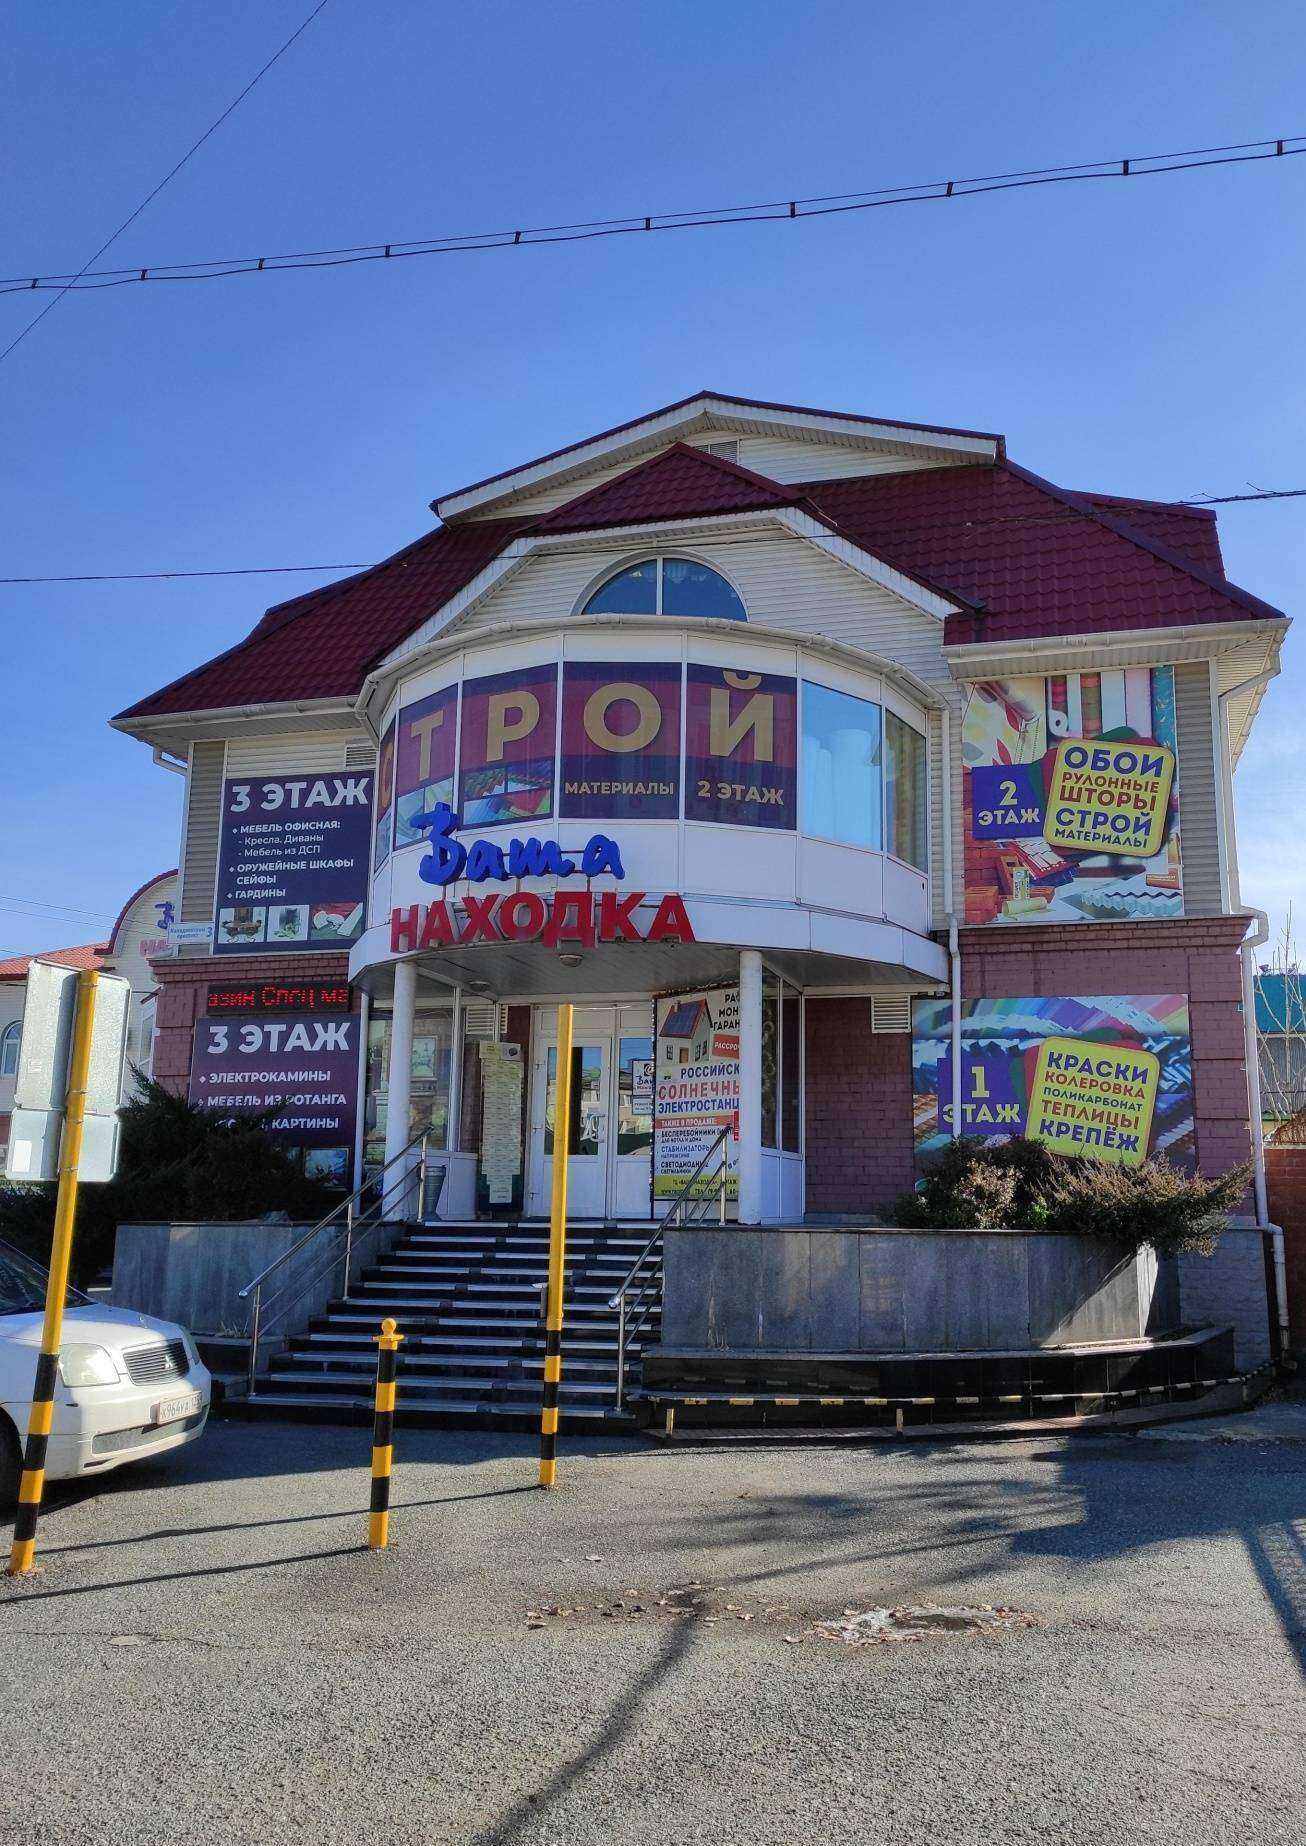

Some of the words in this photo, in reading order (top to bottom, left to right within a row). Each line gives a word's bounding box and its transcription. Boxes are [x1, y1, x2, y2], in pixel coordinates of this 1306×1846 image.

[1064, 746, 1164, 777] ОБОИ
[230, 785, 251, 812] 3
[260, 778, 369, 811] ЭТАЖ
[564, 781, 675, 795] МАТЕРИАЛЫ
[697, 780, 711, 798] 2
[716, 781, 785, 805] ЭТАЖ
[999, 780, 1018, 806] 2
[1062, 772, 1159, 793] РУЛОННЫЕ
[1059, 785, 1156, 812] ШТОРЫ
[240, 823, 282, 834] МЕБЕЛЬ
[285, 821, 341, 832] ОФИСНАЯ:
[978, 807, 1040, 826] ЭТАЖ
[1055, 808, 1152, 836] СТРОЙ
[244, 847, 282, 857] Мебель
[285, 847, 297, 855] из
[298, 845, 320, 856] ДСП
[284, 834, 324, 845] Диваны
[410, 801, 625, 886] Ваша
[1054, 828, 1147, 848] МАТЕРИАЛЫ
[237, 860, 306, 872] ОРУЖЕЙНЫЕ
[309, 859, 353, 870] ШКАФЫ
[236, 874, 276, 885] СЕЙФЫ
[235, 888, 286, 899] ГАРДИНЫ
[390, 891, 696, 952] НАХОДКА
[207, 1026, 228, 1054] 3
[238, 1022, 350, 1053] ЭТАЖ
[209, 1071, 331, 1084] ЭЛЕКТРОКАМИНЫ
[1047, 1051, 1149, 1084] КРАСКИ
[971, 1066, 990, 1098] 1
[1044, 1071, 1146, 1099] КОЛЕРОВКА
[208, 1095, 260, 1107] МЕБЕЛЬ
[1043, 1086, 1142, 1112] ПОЛИКАРБОНАТ
[271, 1117, 338, 1130] КАРТИНЫ
[1041, 1099, 1139, 1130] ТЕПЛИЦЫ
[1039, 1118, 1139, 1153] КРЕПЁЖ
